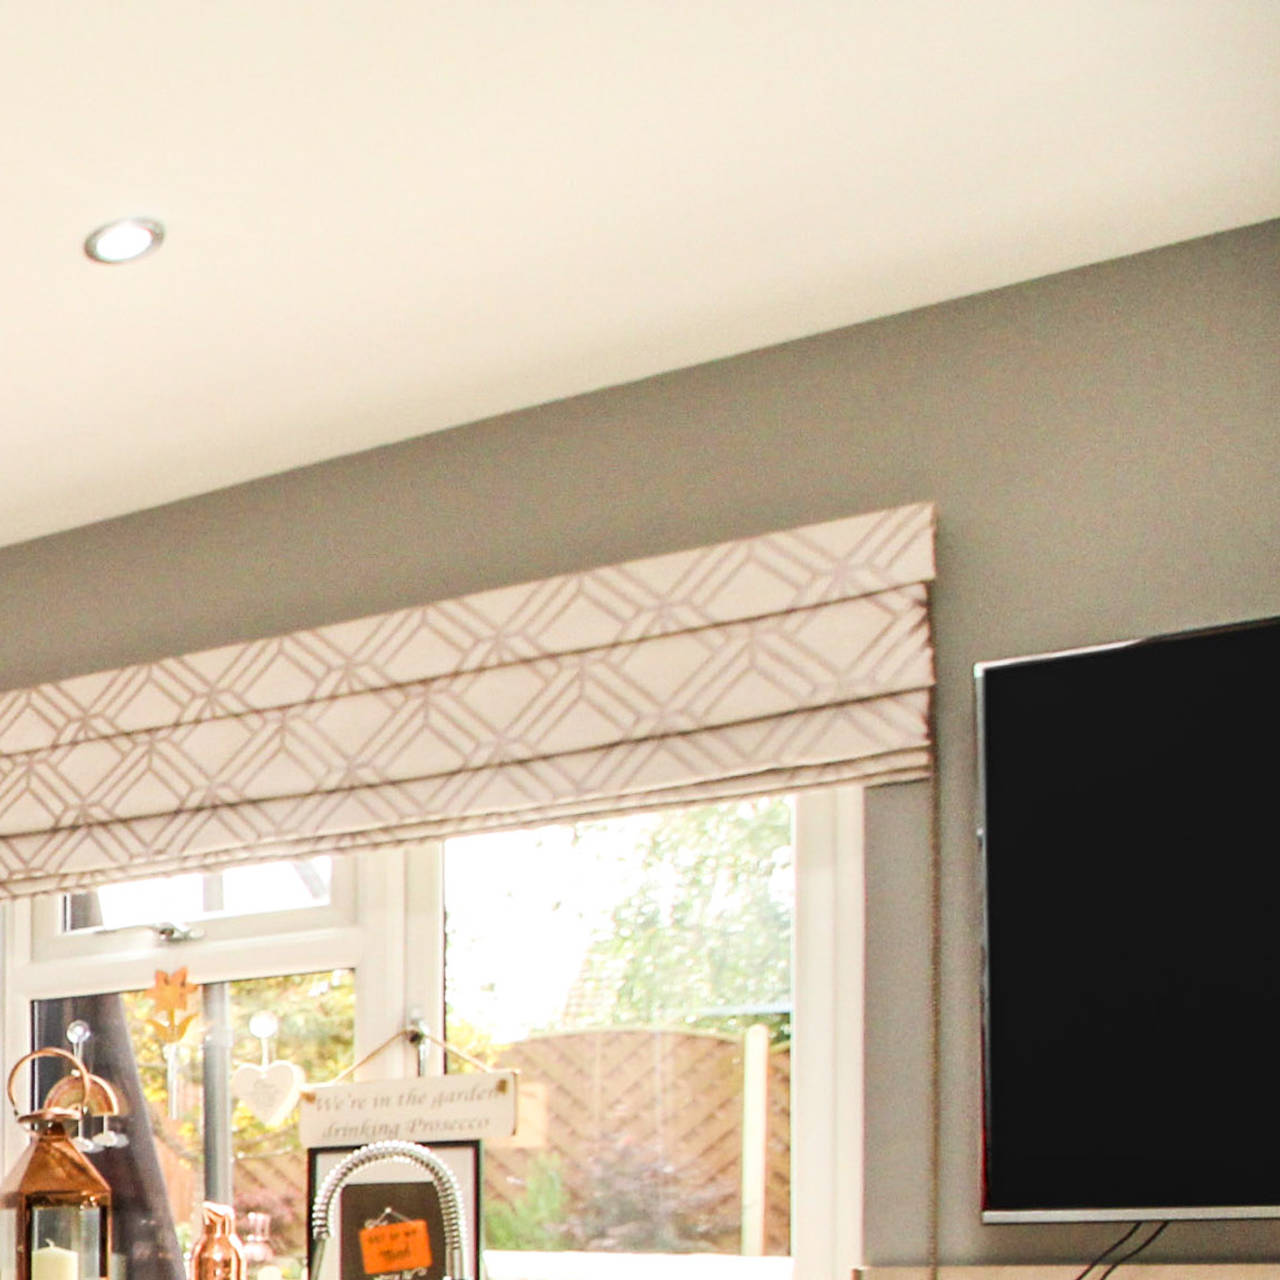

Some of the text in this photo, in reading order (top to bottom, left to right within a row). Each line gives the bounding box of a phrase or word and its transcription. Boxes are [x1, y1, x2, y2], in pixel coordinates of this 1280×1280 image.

[314, 1083, 501, 1113] We're in the garden
[321, 1114, 492, 1141] drinking Prosecco
